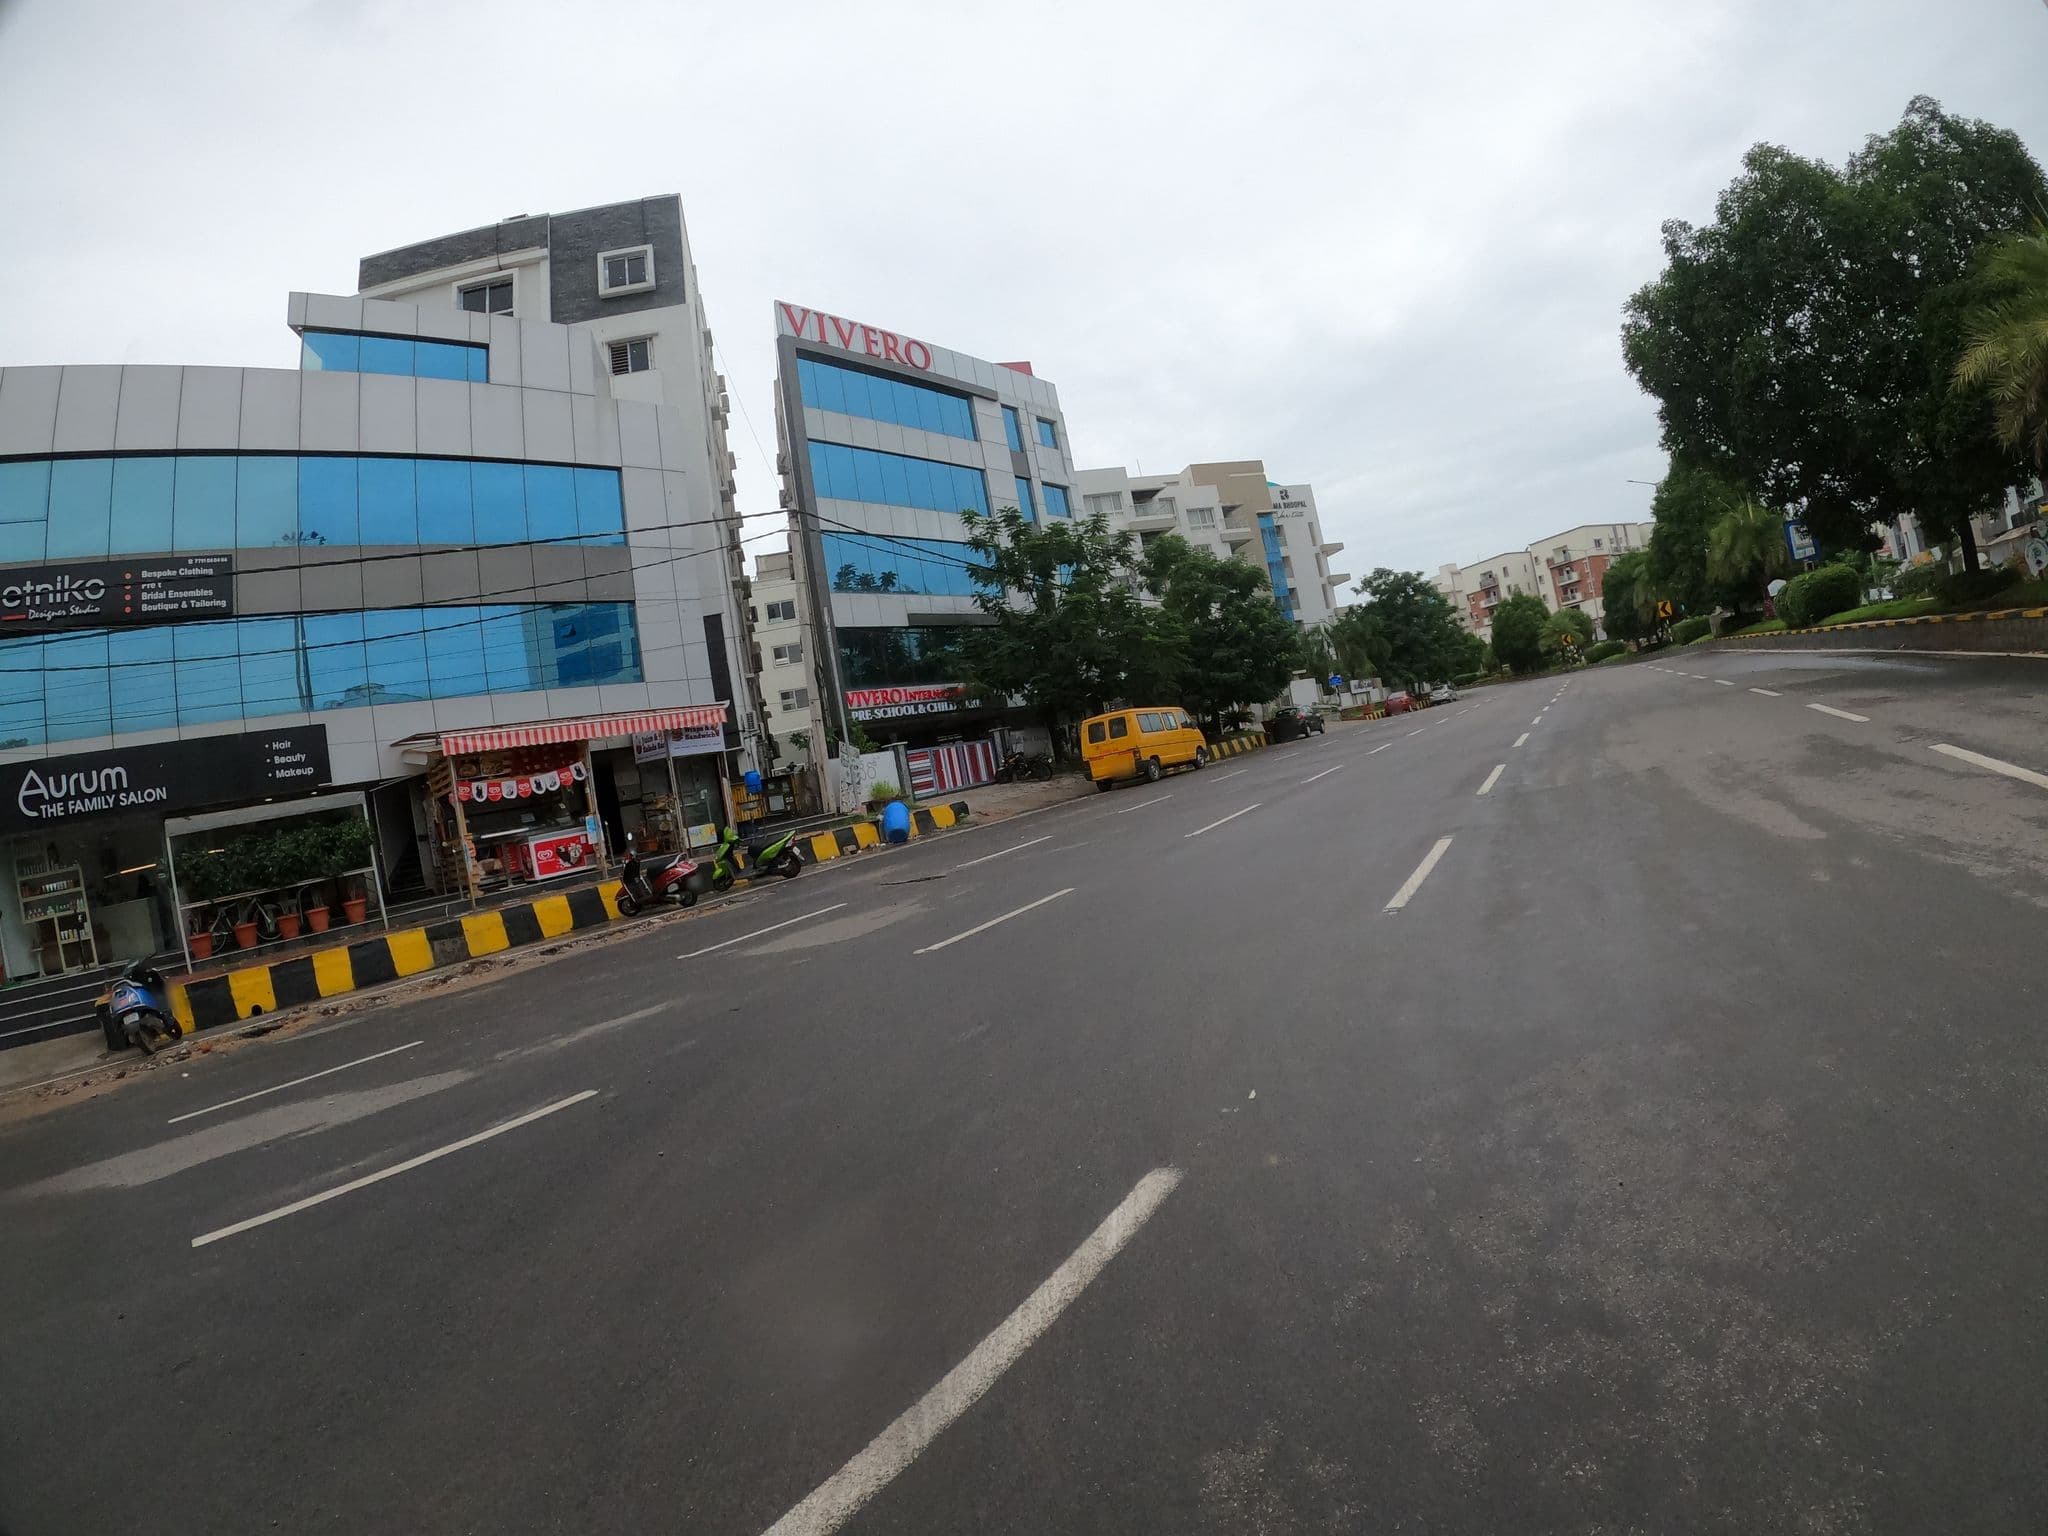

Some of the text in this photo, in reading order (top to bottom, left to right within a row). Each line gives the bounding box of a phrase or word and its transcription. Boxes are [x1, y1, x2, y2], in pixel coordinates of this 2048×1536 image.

[779, 302, 931, 371] VIVERO
[141, 567, 214, 579] Bespoke Clothing
[141, 588, 214, 600] Bridal Ensembles
[69, 603, 101, 616] Studio
[141, 598, 226, 612] Boutique & Tailoring
[846, 688, 903, 709] VIVERO
[851, 704, 918, 721] PRE-SCHOOL
[918, 703, 927, 714] &
[272, 739, 292, 751] Hair
[273, 751, 306, 766] Beauty
[275, 765, 314, 780] Makeup
[17, 765, 129, 818] Aurum
[39, 786, 168, 819] THE FAMILY SALON
